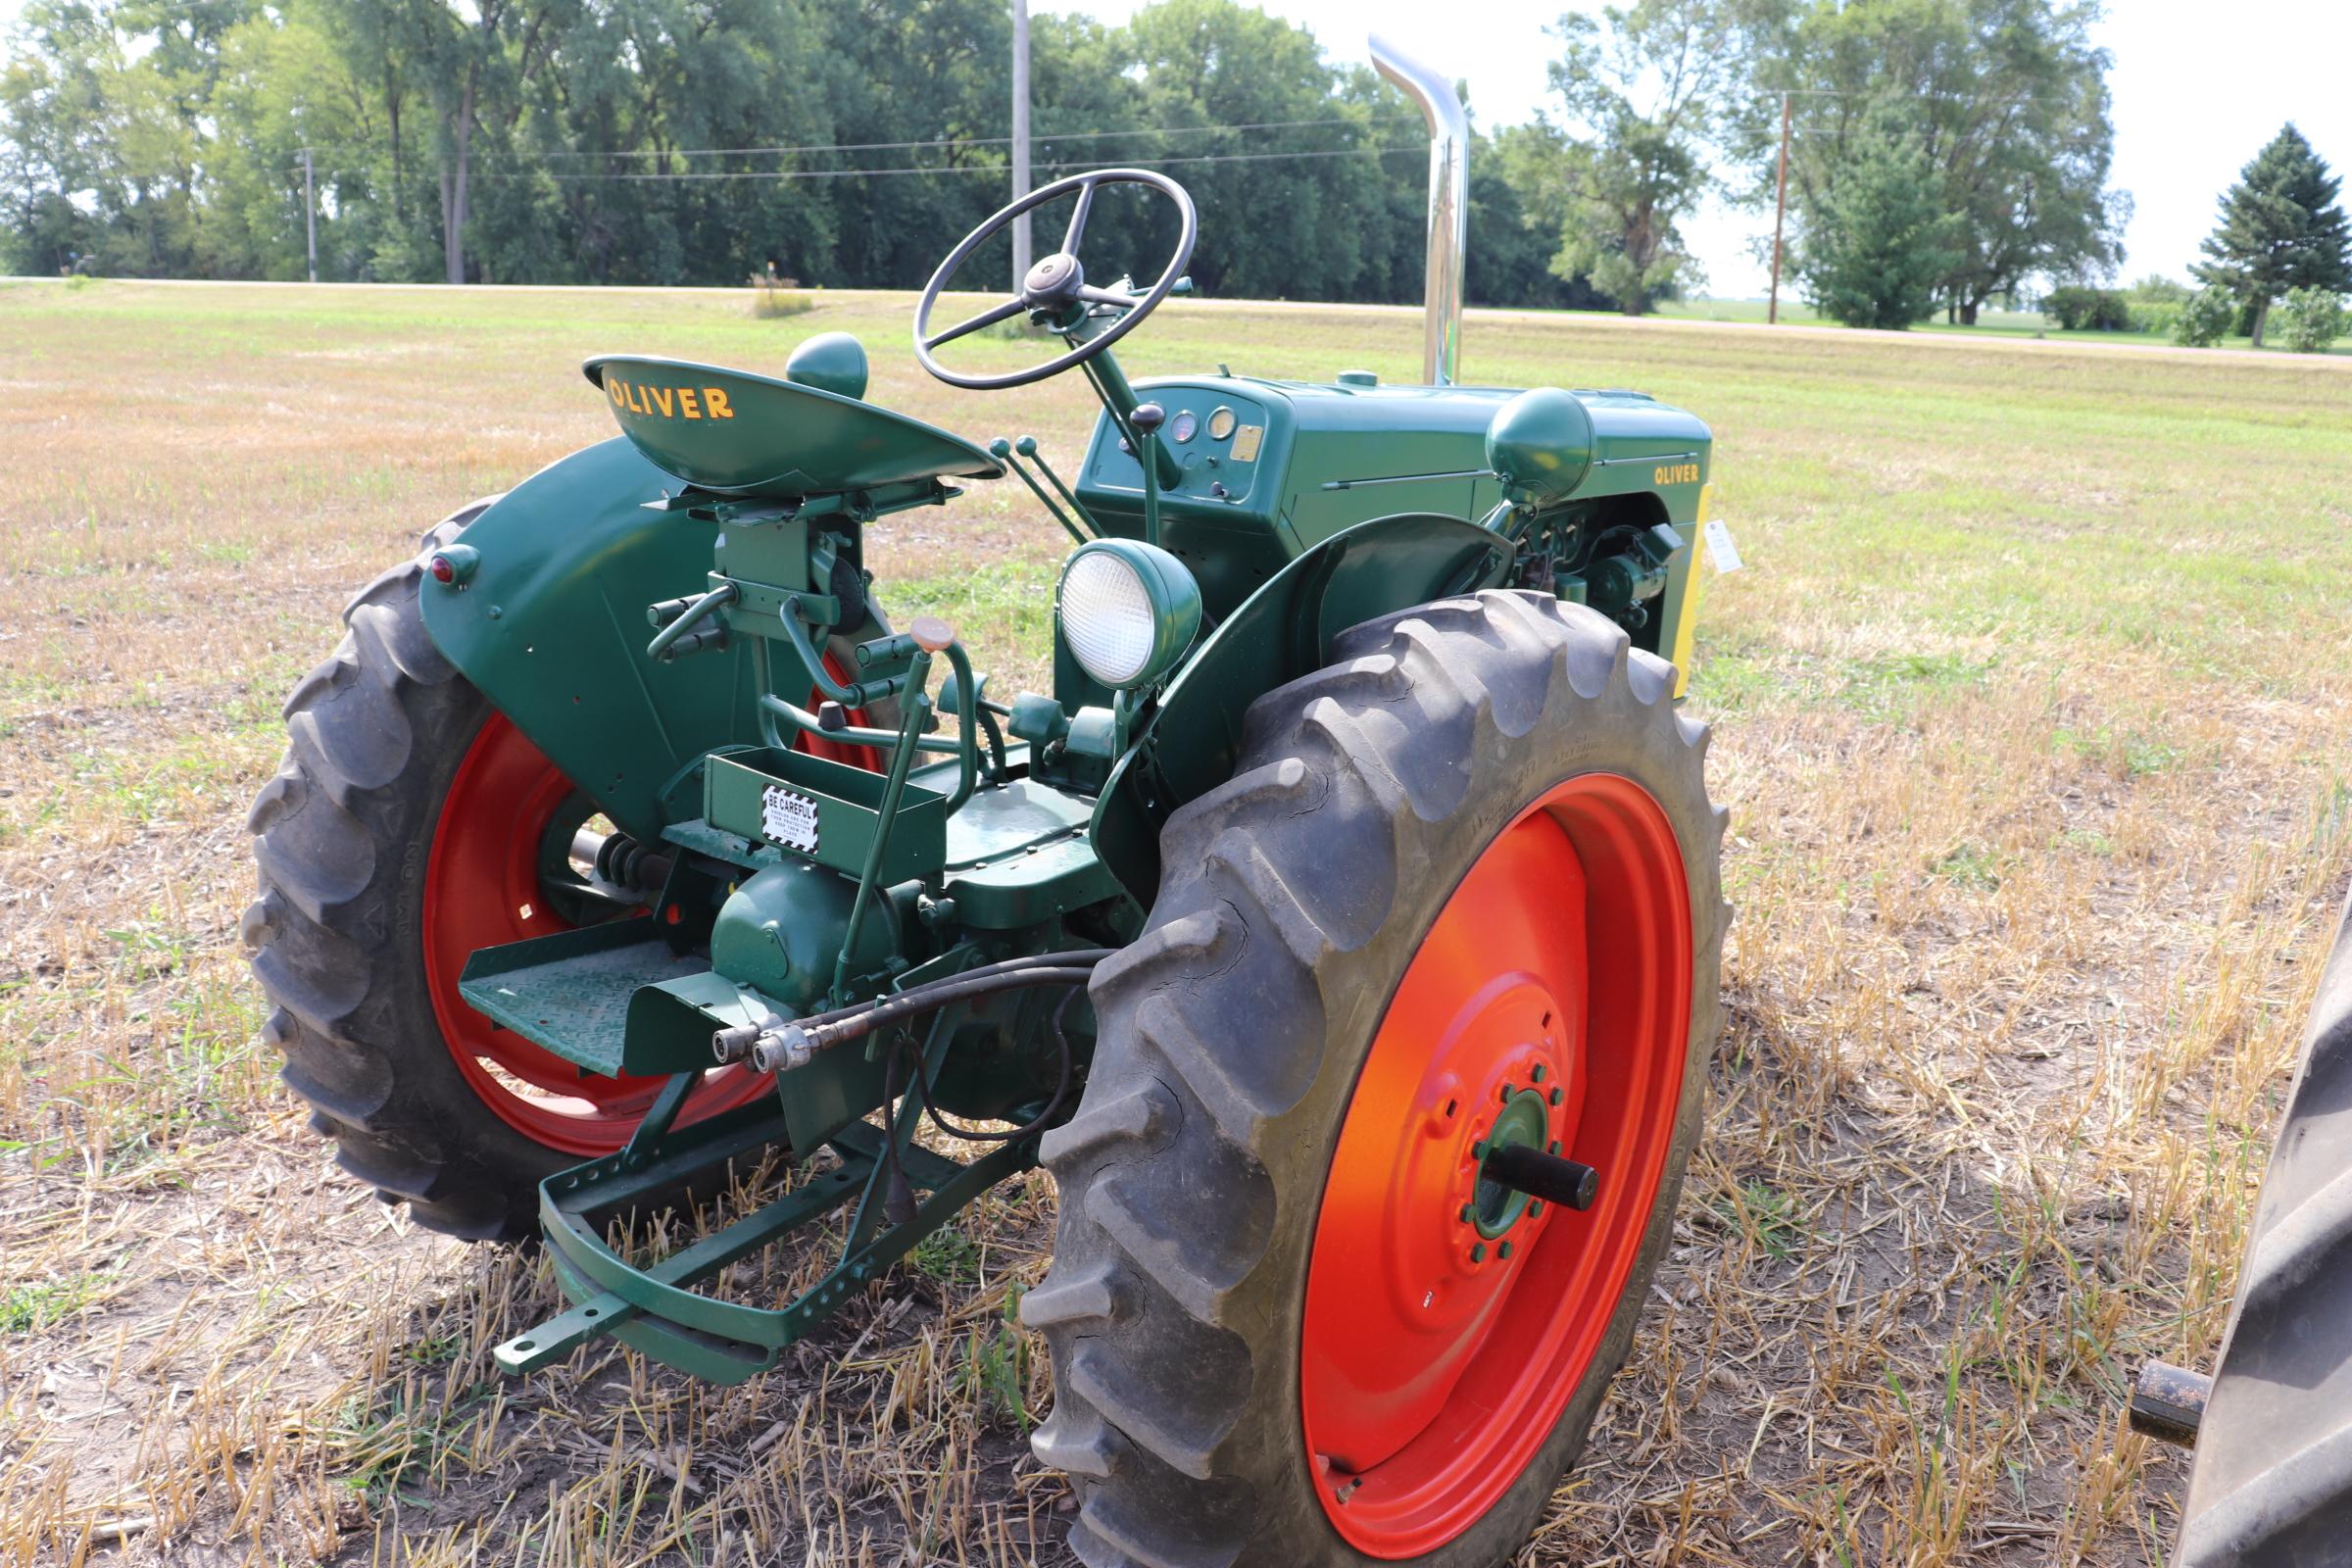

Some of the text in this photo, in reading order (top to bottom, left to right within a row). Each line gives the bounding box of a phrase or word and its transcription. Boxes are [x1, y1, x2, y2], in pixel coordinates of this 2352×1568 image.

[609, 377, 735, 419] OLIVER
[1654, 464, 1699, 485] OLIVER
[768, 794, 811, 819] BE CAREFUL
